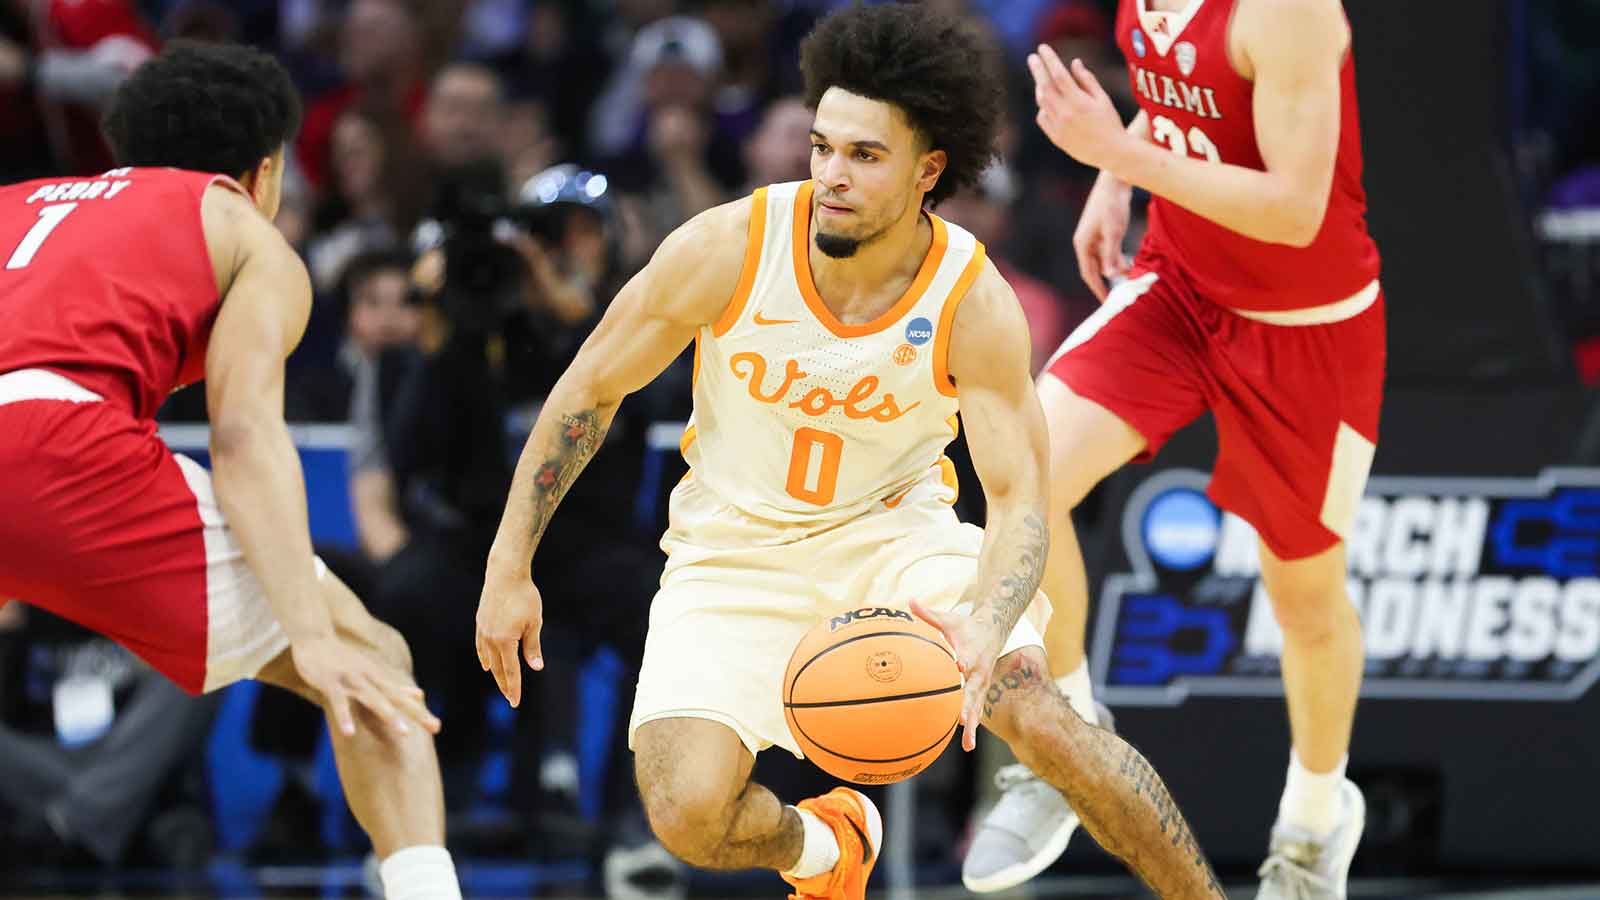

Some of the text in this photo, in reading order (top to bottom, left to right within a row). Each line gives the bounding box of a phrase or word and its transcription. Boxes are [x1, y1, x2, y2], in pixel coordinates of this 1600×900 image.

[1131, 63, 1222, 119] MIAMI
[25, 180, 132, 204] PERRY
[5, 202, 79, 270] 1
[730, 352, 921, 422] Vols
[785, 427, 844, 507] 0
[1213, 497, 1490, 577] RCH
[830, 607, 914, 631] NCAA
[1244, 577, 1600, 662] DNESS
